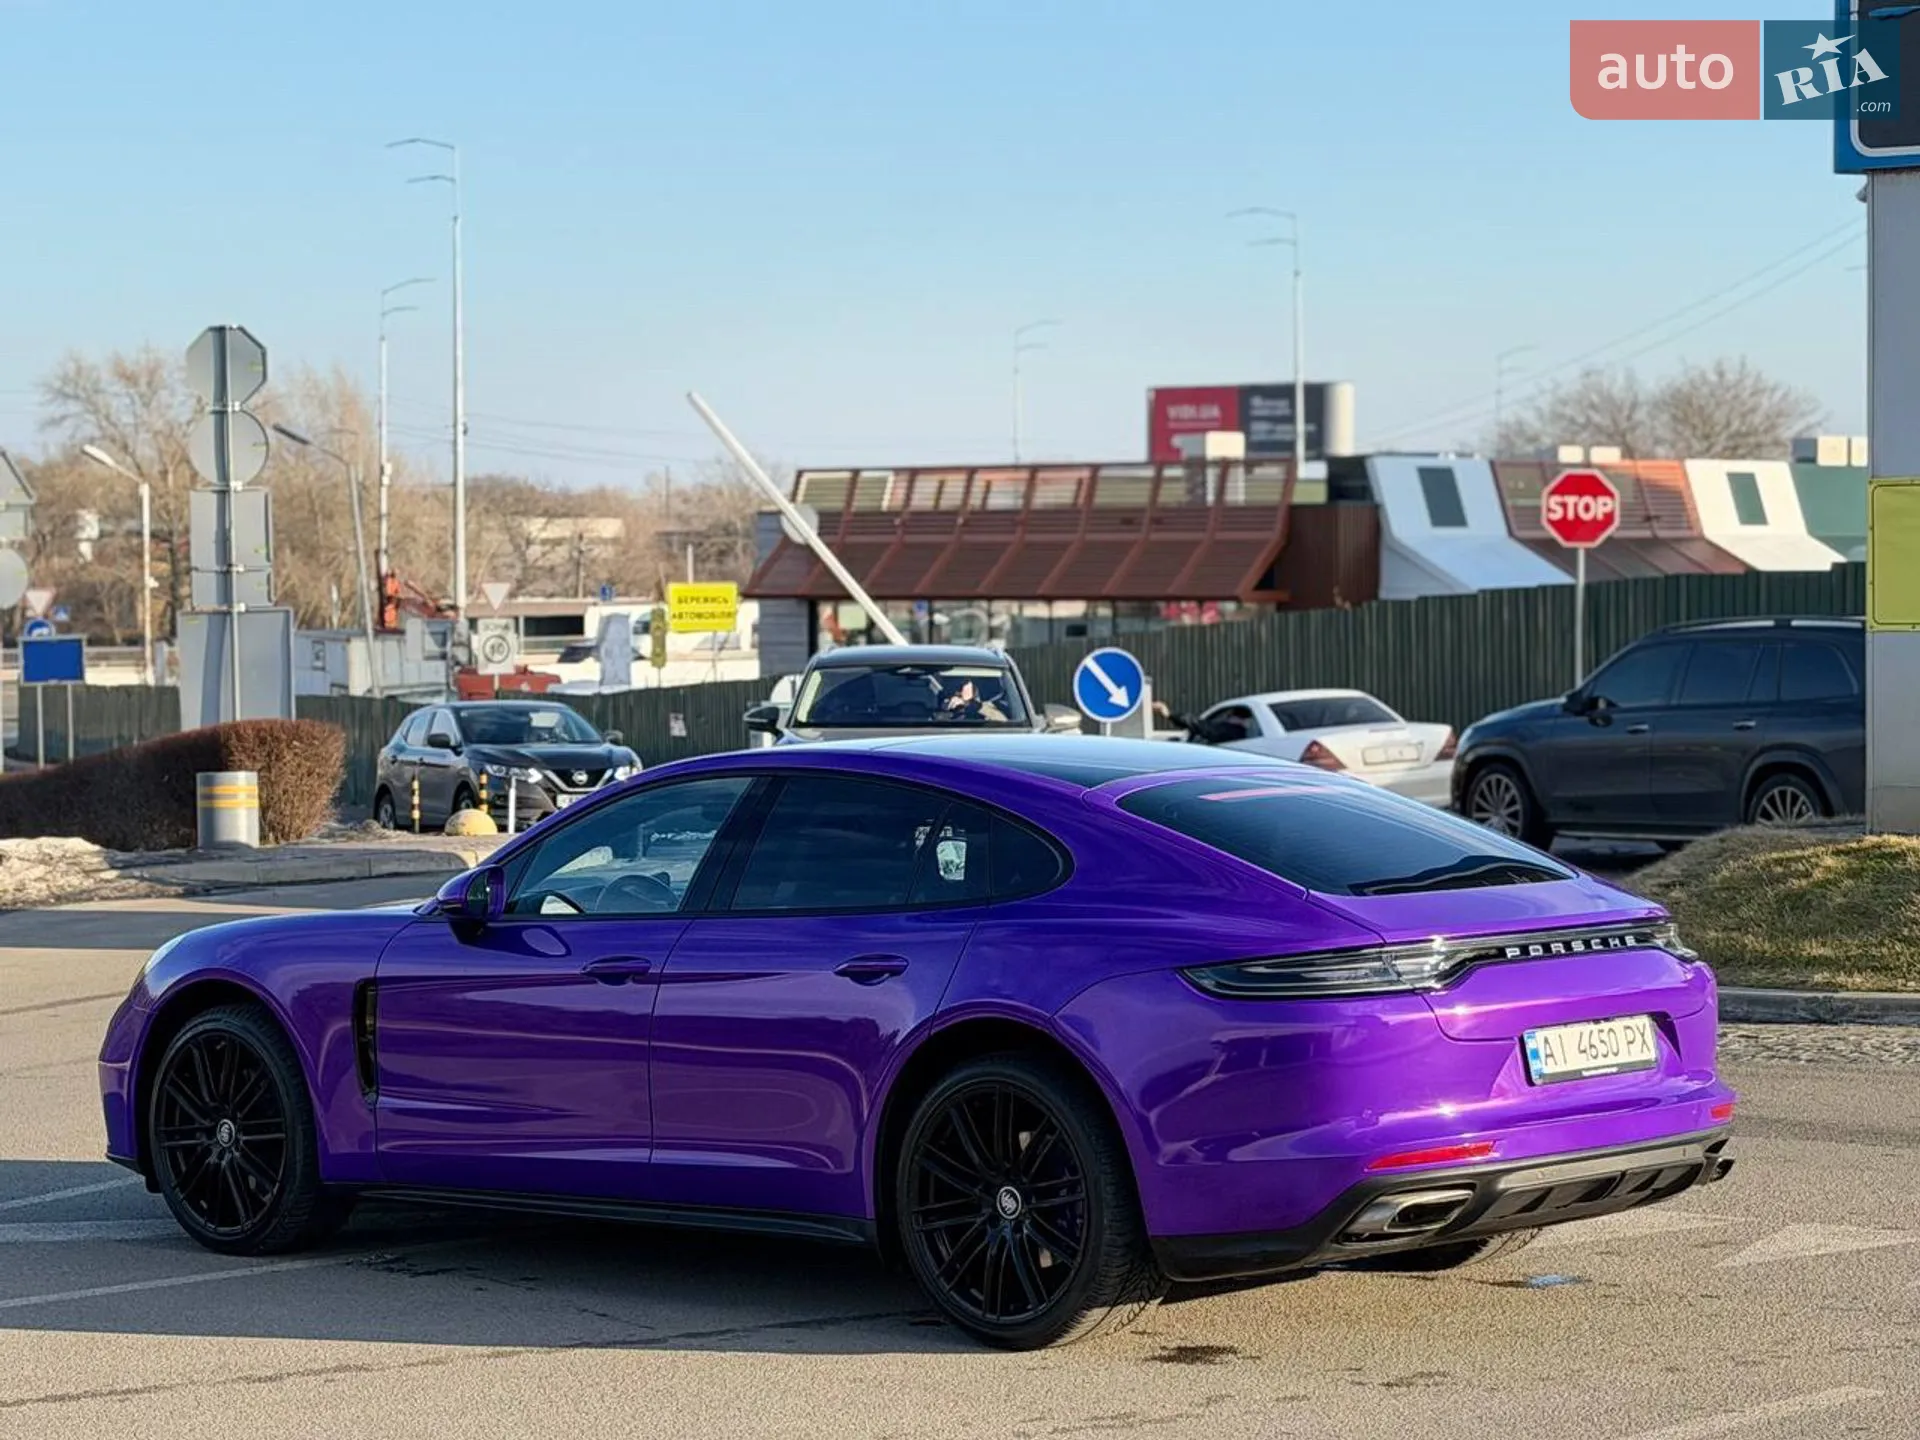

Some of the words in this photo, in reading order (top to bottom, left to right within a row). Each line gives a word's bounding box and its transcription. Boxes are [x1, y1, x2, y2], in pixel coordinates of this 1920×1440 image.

[1547, 494, 1613, 521] STOP
[1505, 935, 1637, 959] PORSCHE
[1543, 1034, 1568, 1067] AI
[1577, 1028, 1620, 1061] 4650
[1624, 1022, 1652, 1056] PX
